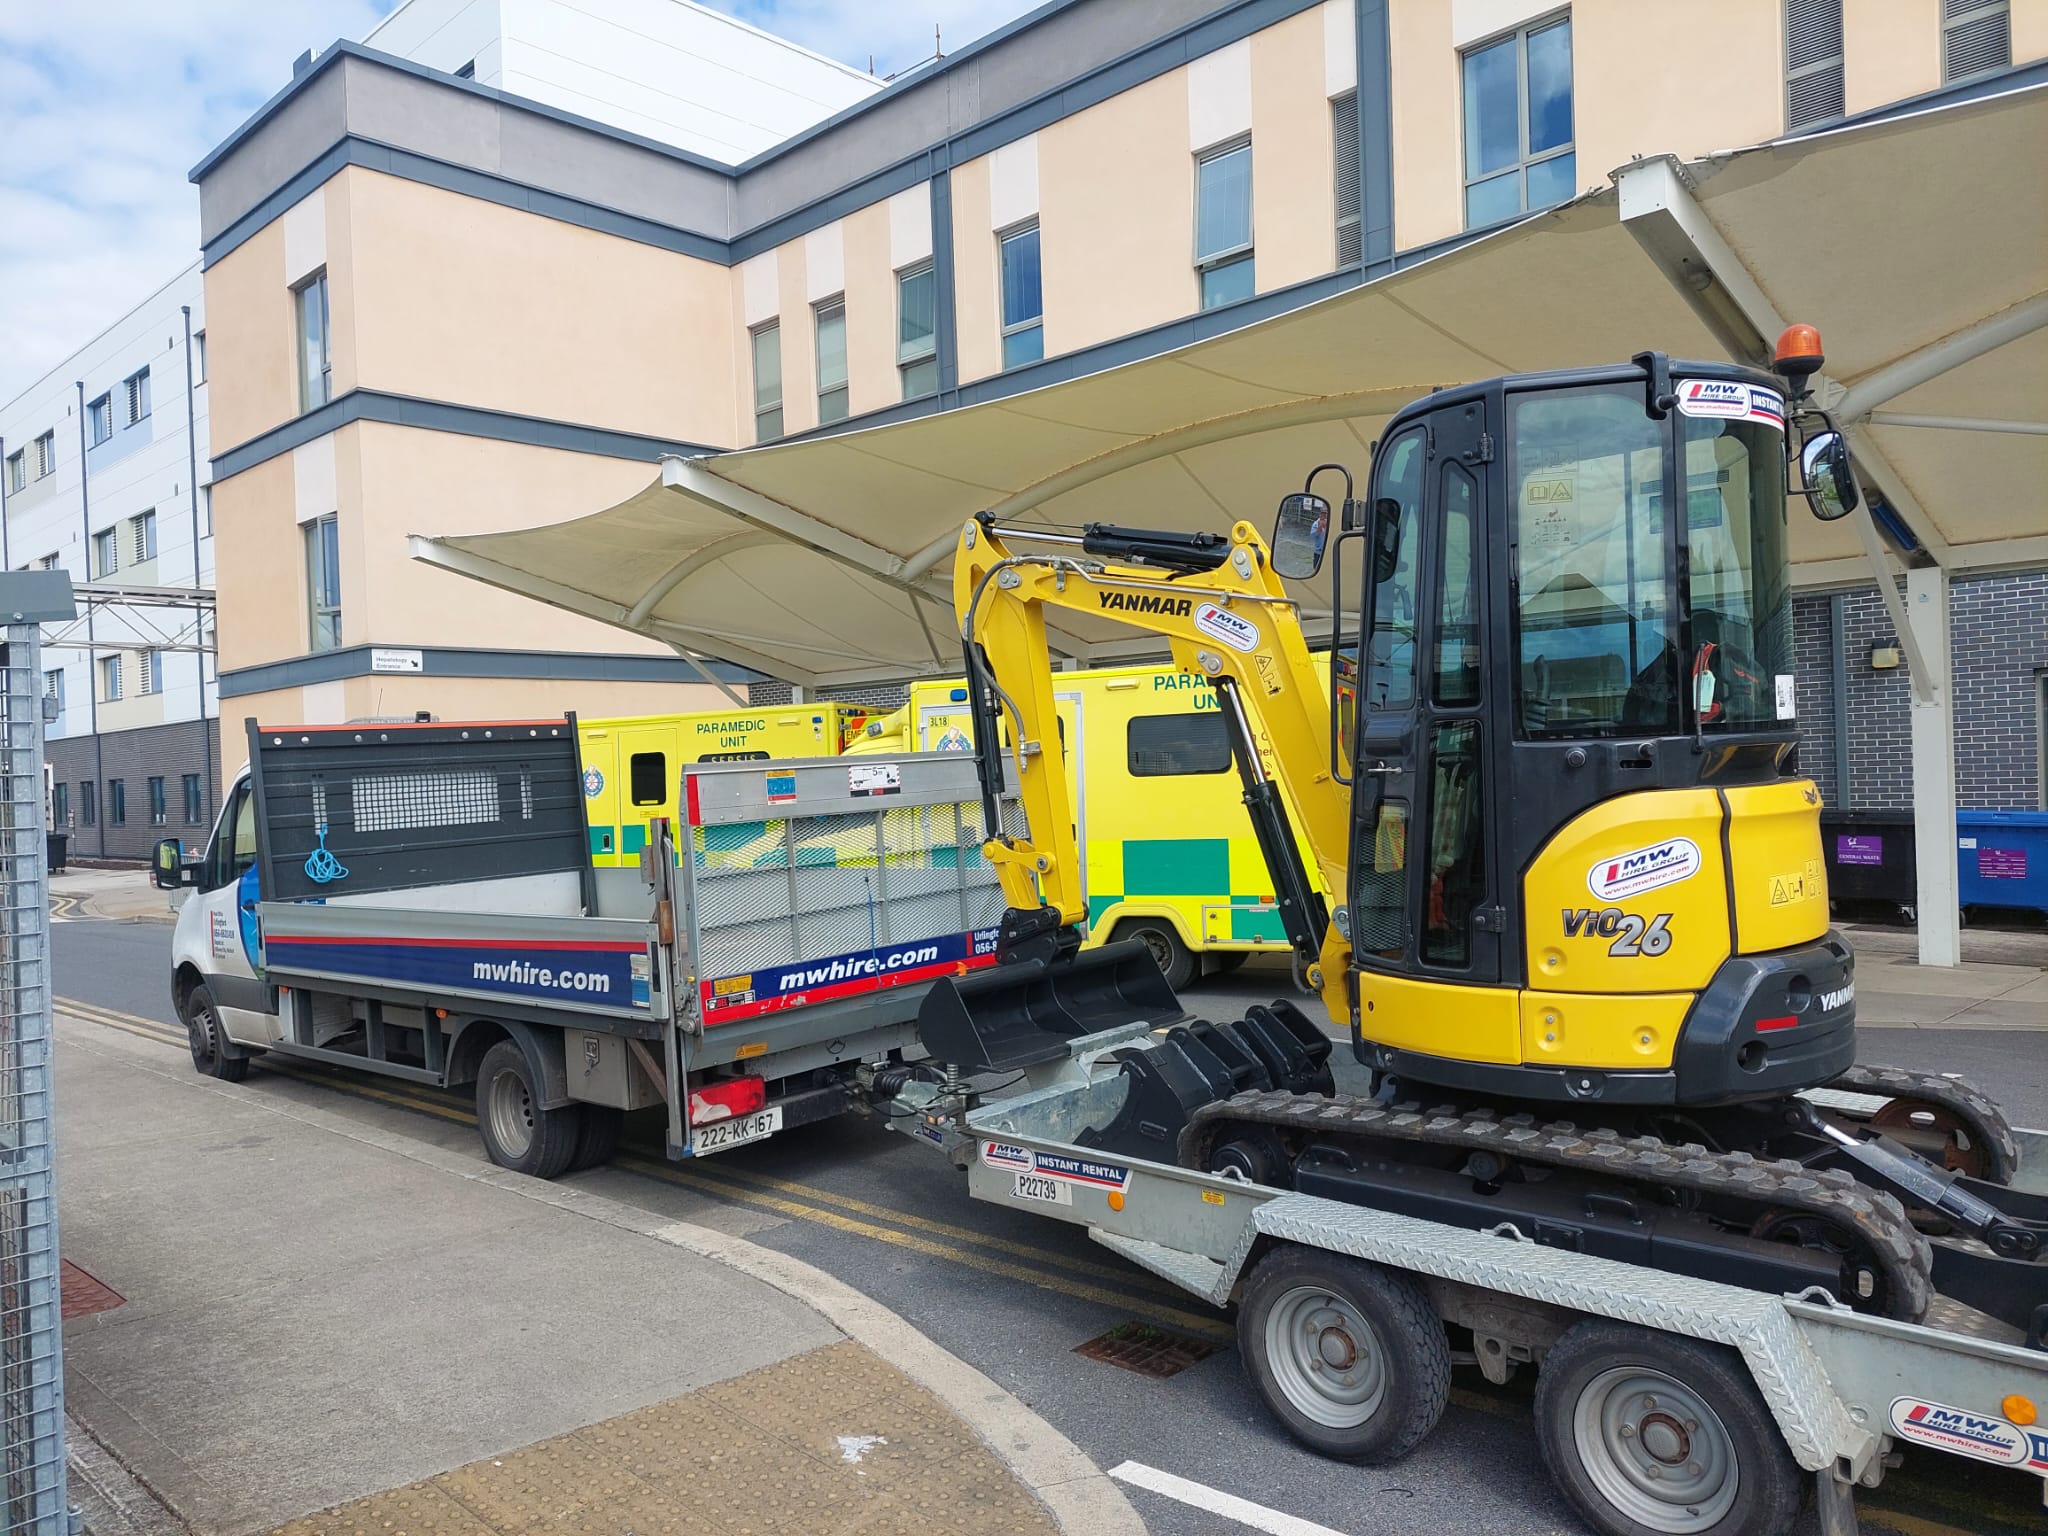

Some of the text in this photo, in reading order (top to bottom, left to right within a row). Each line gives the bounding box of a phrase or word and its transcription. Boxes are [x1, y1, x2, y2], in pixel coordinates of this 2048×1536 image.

[1704, 383, 1738, 394] MW
[1099, 591, 1193, 617] YANMAR
[1217, 614, 1248, 630] MW
[696, 719, 766, 734] PARAMEDIC
[930, 716, 948, 727] 3L18
[720, 735, 748, 748] UNIT
[1621, 851, 1690, 878] HIRE GROUP
[1623, 845, 1675, 871] MW
[1605, 865, 1690, 896] www.mwhire.com
[473, 960, 610, 993] mwhire.com
[779, 945, 938, 990] mwhire.com
[1820, 982, 1854, 1011] YANMA
[700, 1112, 774, 1149] 222-KK-167
[996, 1144, 1024, 1155] MW
[1038, 1155, 1123, 1180] INSTANT RENTAL
[1019, 1175, 1057, 1201] P22739
[1927, 1418, 2017, 1445] HIRE GROUP
[1932, 1409, 2001, 1433] MW
[1903, 1425, 2012, 1458] www.mwhire.com
